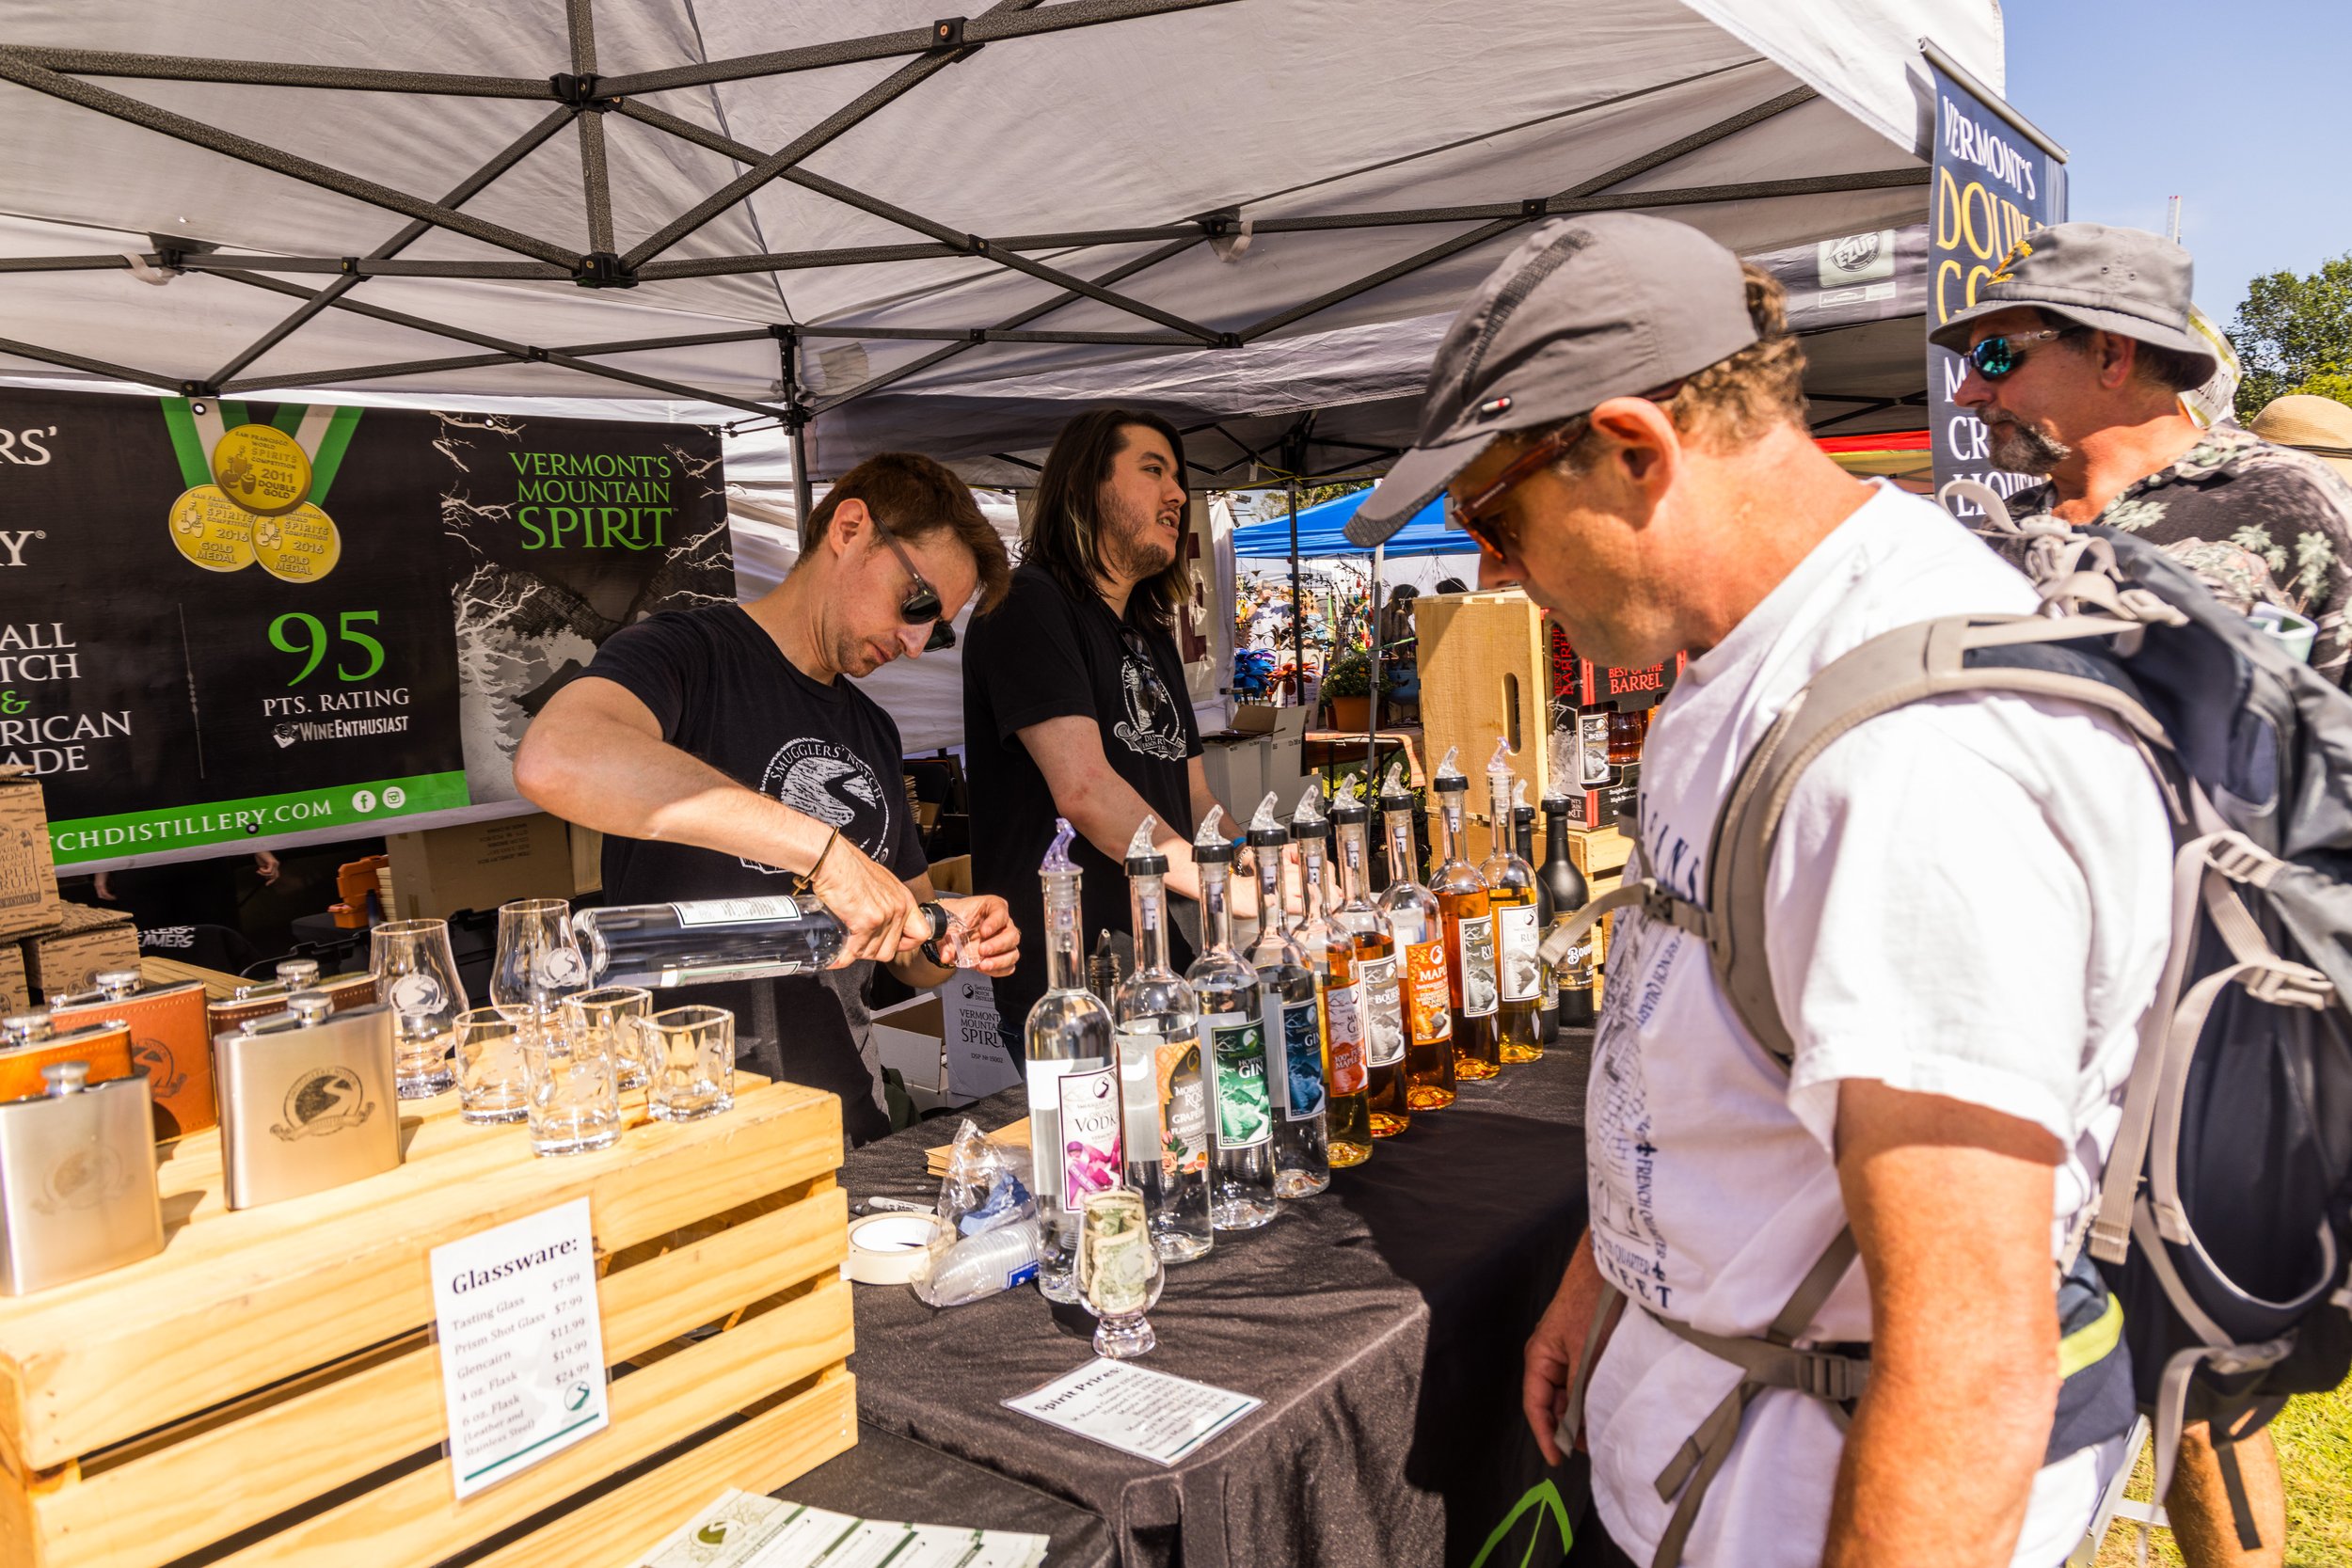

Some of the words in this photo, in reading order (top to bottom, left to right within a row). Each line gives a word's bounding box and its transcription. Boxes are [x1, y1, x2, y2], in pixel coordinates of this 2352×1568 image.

[1942, 95, 2037, 201] VERMONT'S
[251, 435, 289, 447] FRANCISCO
[251, 441, 276, 451] WORLD
[251, 448, 298, 464] SPIRITS
[251, 456, 297, 470] COMPETITION
[508, 451, 672, 479] VERMONT'S
[261, 468, 294, 484] 2011
[258, 480, 296, 494] DOUBLE
[263, 489, 292, 499] GOLD
[517, 480, 671, 504] MOUNTAIN
[206, 508, 254, 523] SPIRITS
[215, 528, 249, 543] 2016
[284, 522, 329, 536] SPIRITS
[284, 530, 328, 542] COMPETITION
[516, 507, 673, 551] SPIRIT
[196, 549, 237, 564] MEDAL
[199, 542, 233, 554] GOLD
[293, 541, 325, 555] 2016
[278, 553, 310, 566] GOLD
[274, 562, 312, 576] MEDAL
[268, 610, 385, 687] 95
[1610, 672, 1663, 695] BARREL
[1, 689, 31, 715] &
[262, 696, 312, 717] PTS.
[318, 688, 410, 712] RATING
[770, 744, 846, 783] SMUGGLERS'
[847, 752, 883, 800] NOTCH
[49, 799, 333, 852] CHDISTILLERY.COM
[961, 1019, 998, 1032] MOUNTA
[1238, 1062, 1264, 1079] GIN
[1635, 1158, 1654, 1212] FRENCH
[452, 1238, 578, 1295] Glassware:
[453, 1308, 495, 1332] Tasting
[496, 1296, 525, 1314] Glass
[552, 1272, 580, 1292] $7.99
[453, 1335, 488, 1355] Prism
[490, 1323, 515, 1341] Shot
[517, 1313, 546, 1330] Glass
[554, 1295, 582, 1315] $7.99
[457, 1351, 512, 1380] Glencairn
[550, 1317, 585, 1340] $11.99
[488, 1370, 517, 1391] Flask
[552, 1339, 587, 1363] $19.99
[491, 1394, 520, 1415] Flask
[555, 1361, 590, 1386] $24.99
[1035, 1390, 1078, 1413] Spirit
[1074, 1367, 1124, 1391] Prices:
[507, 1408, 525, 1424] and
